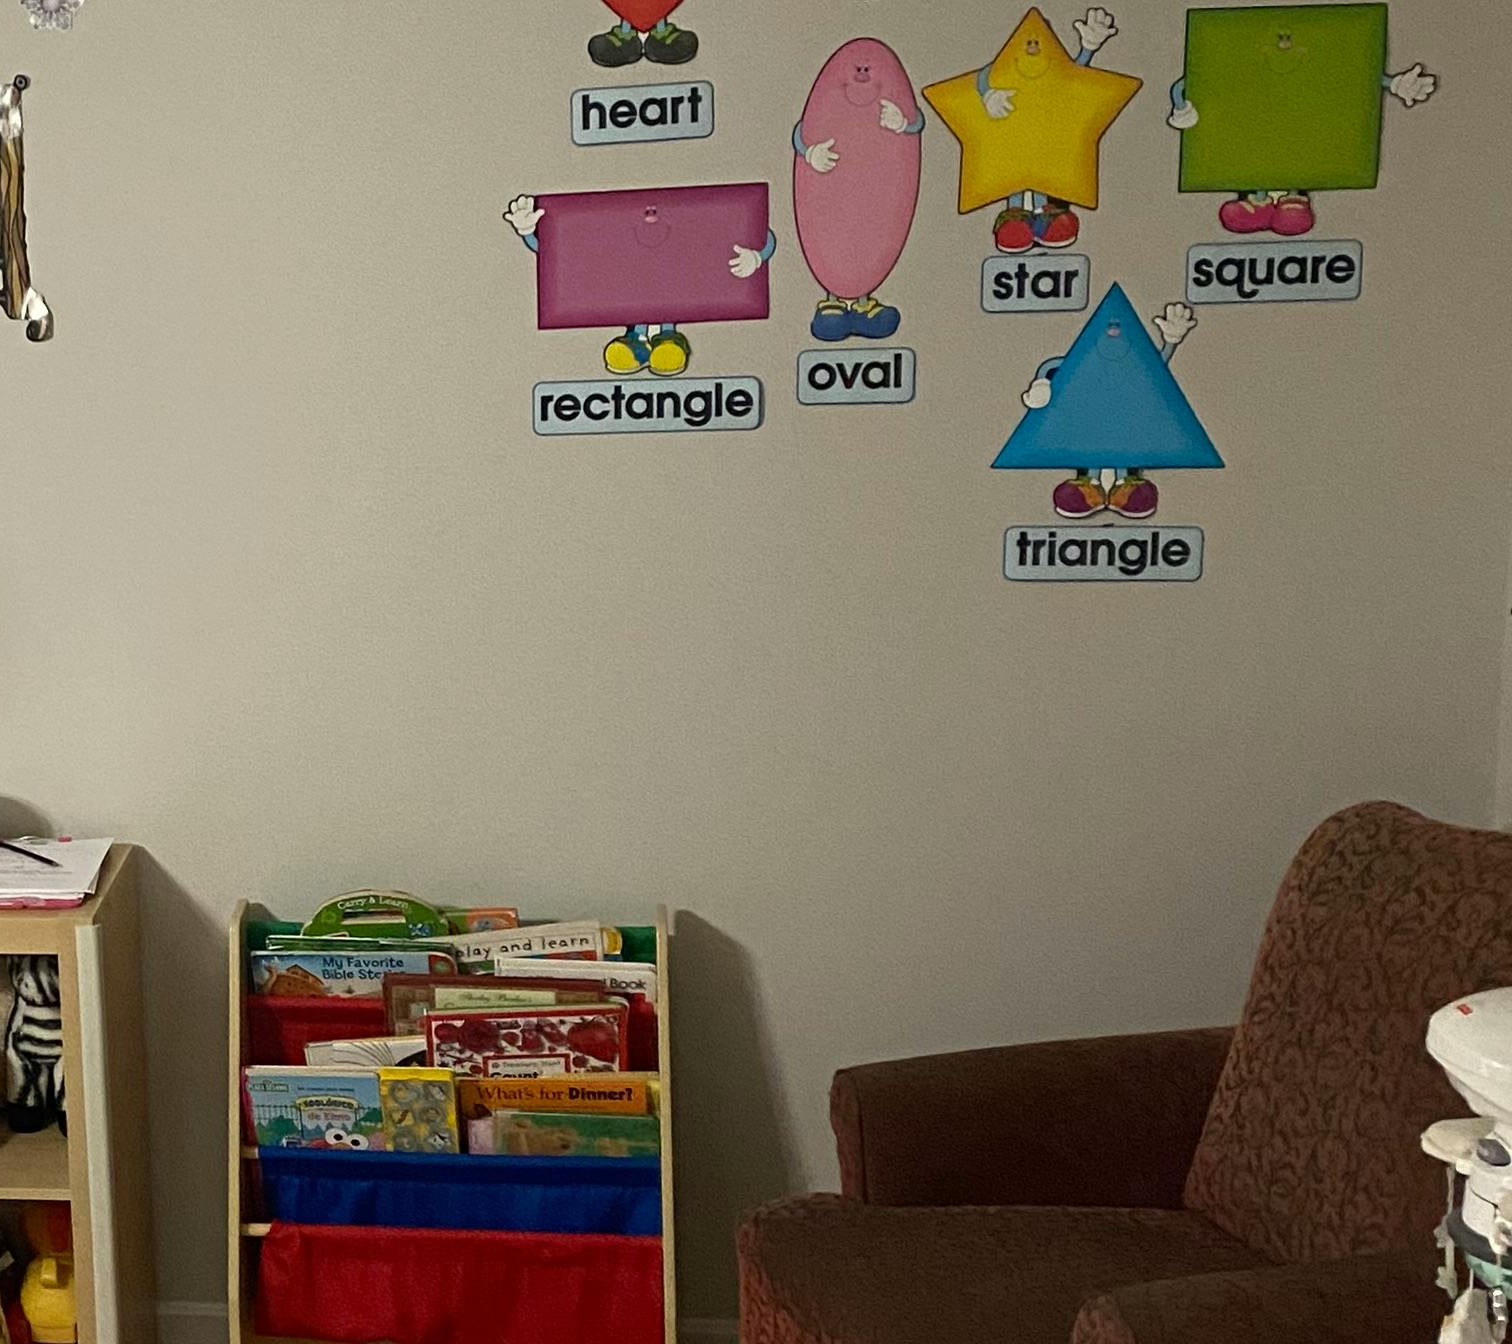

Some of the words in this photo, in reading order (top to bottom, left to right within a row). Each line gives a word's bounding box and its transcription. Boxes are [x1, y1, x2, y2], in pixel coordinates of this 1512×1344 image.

[582, 87, 702, 130] heart
[992, 262, 1079, 300] star
[1192, 251, 1356, 298] square
[807, 353, 902, 390] oval
[540, 383, 754, 426] rectangle
[1016, 532, 1191, 576] triangle
[337, 897, 367, 910] Carry
[500, 940, 532, 953] and
[542, 936, 590, 950] learn
[323, 958, 343, 970] My
[347, 957, 404, 968] Favorite
[323, 969, 354, 980] Bible
[610, 977, 647, 991] Book
[478, 1087, 534, 1101] What's
[540, 1087, 564, 1101] for
[568, 1087, 633, 1101] Dinner?
